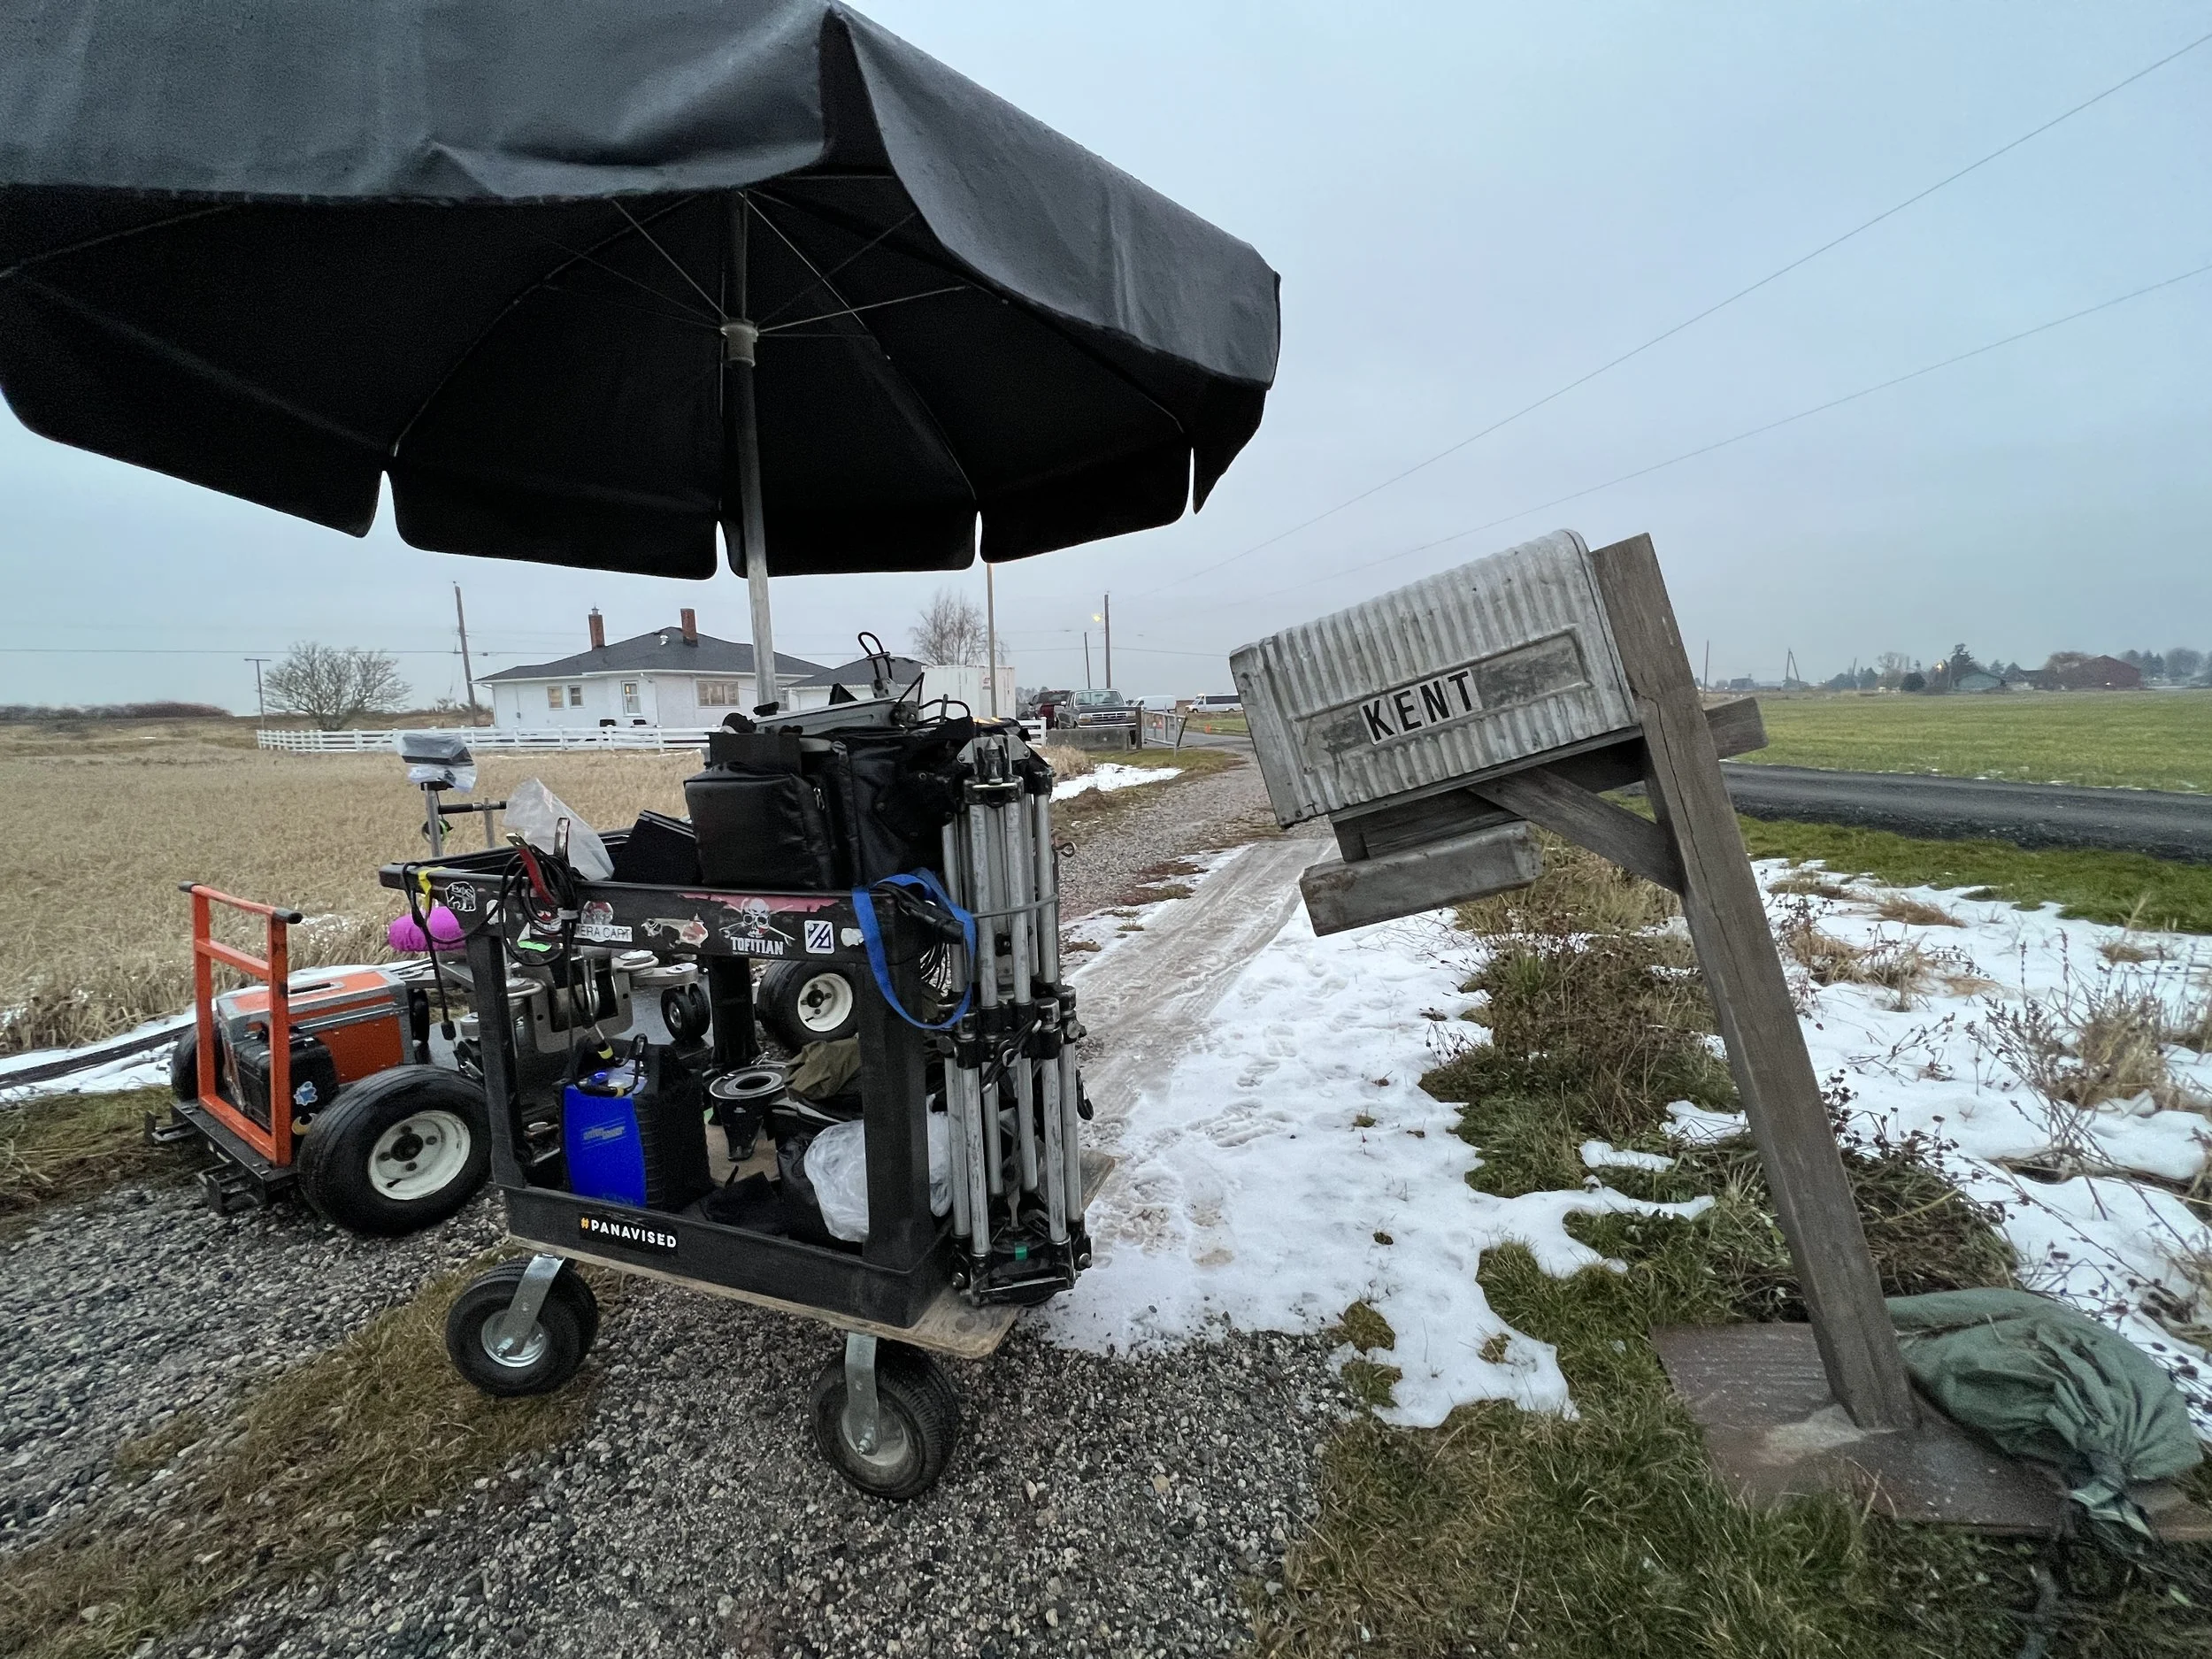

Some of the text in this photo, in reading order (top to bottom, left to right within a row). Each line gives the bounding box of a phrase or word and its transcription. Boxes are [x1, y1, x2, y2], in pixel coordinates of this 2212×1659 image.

[1363, 671, 1472, 741] KENT
[730, 936, 784, 956] TOFITIAN
[580, 1217, 677, 1248] #PANAVISED
